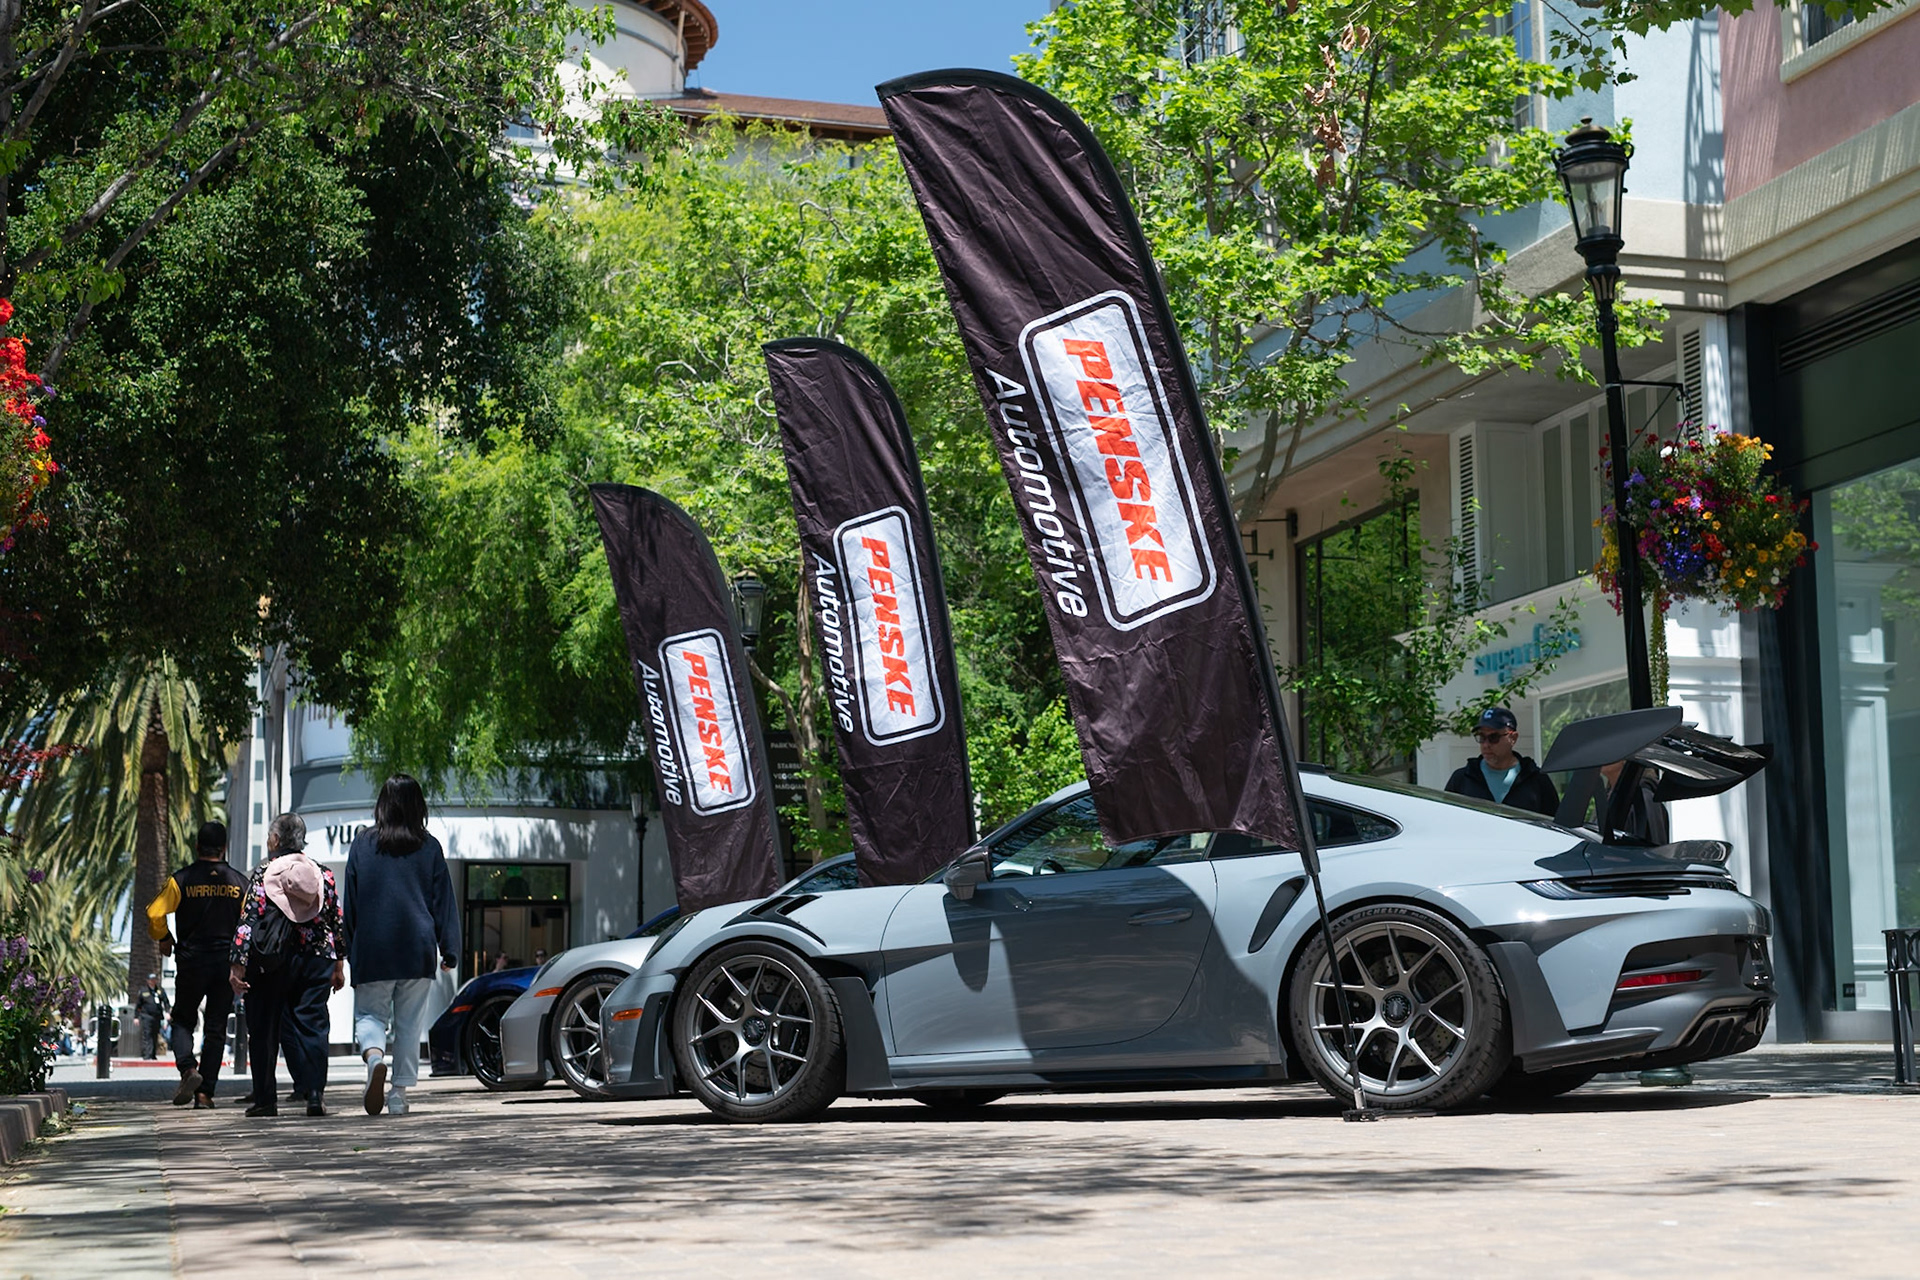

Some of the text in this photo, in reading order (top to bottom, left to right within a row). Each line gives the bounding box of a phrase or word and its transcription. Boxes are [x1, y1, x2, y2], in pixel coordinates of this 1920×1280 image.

[985, 366, 1090, 619] Automotive
[1062, 338, 1174, 584] PENSKE
[811, 551, 856, 734] Automotive
[861, 536, 917, 718] PENSKE
[637, 658, 683, 807] Automotive
[682, 650, 734, 795] PENSKE
[185, 884, 241, 899] WARRIORS
[1352, 906, 1408, 920] MICHELIN
